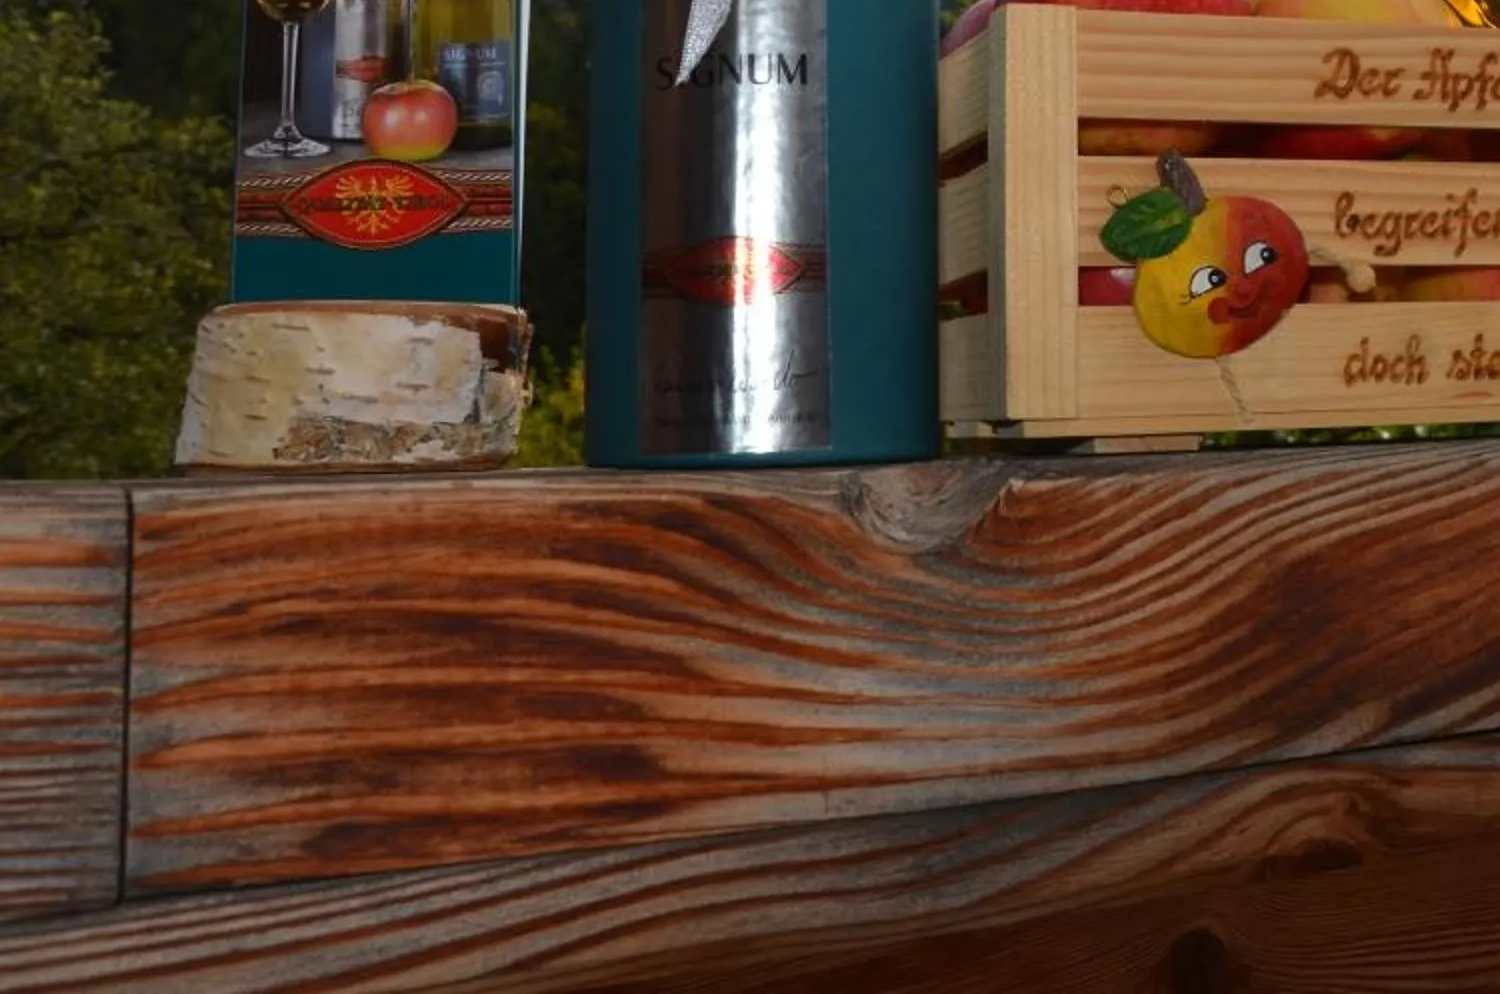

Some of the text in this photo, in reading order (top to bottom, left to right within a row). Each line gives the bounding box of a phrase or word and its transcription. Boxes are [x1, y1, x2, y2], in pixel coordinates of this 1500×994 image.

[656, 53, 808, 91] SGNUM
[1314, 48, 1405, 100] Der
[1343, 333, 1430, 388] doch
